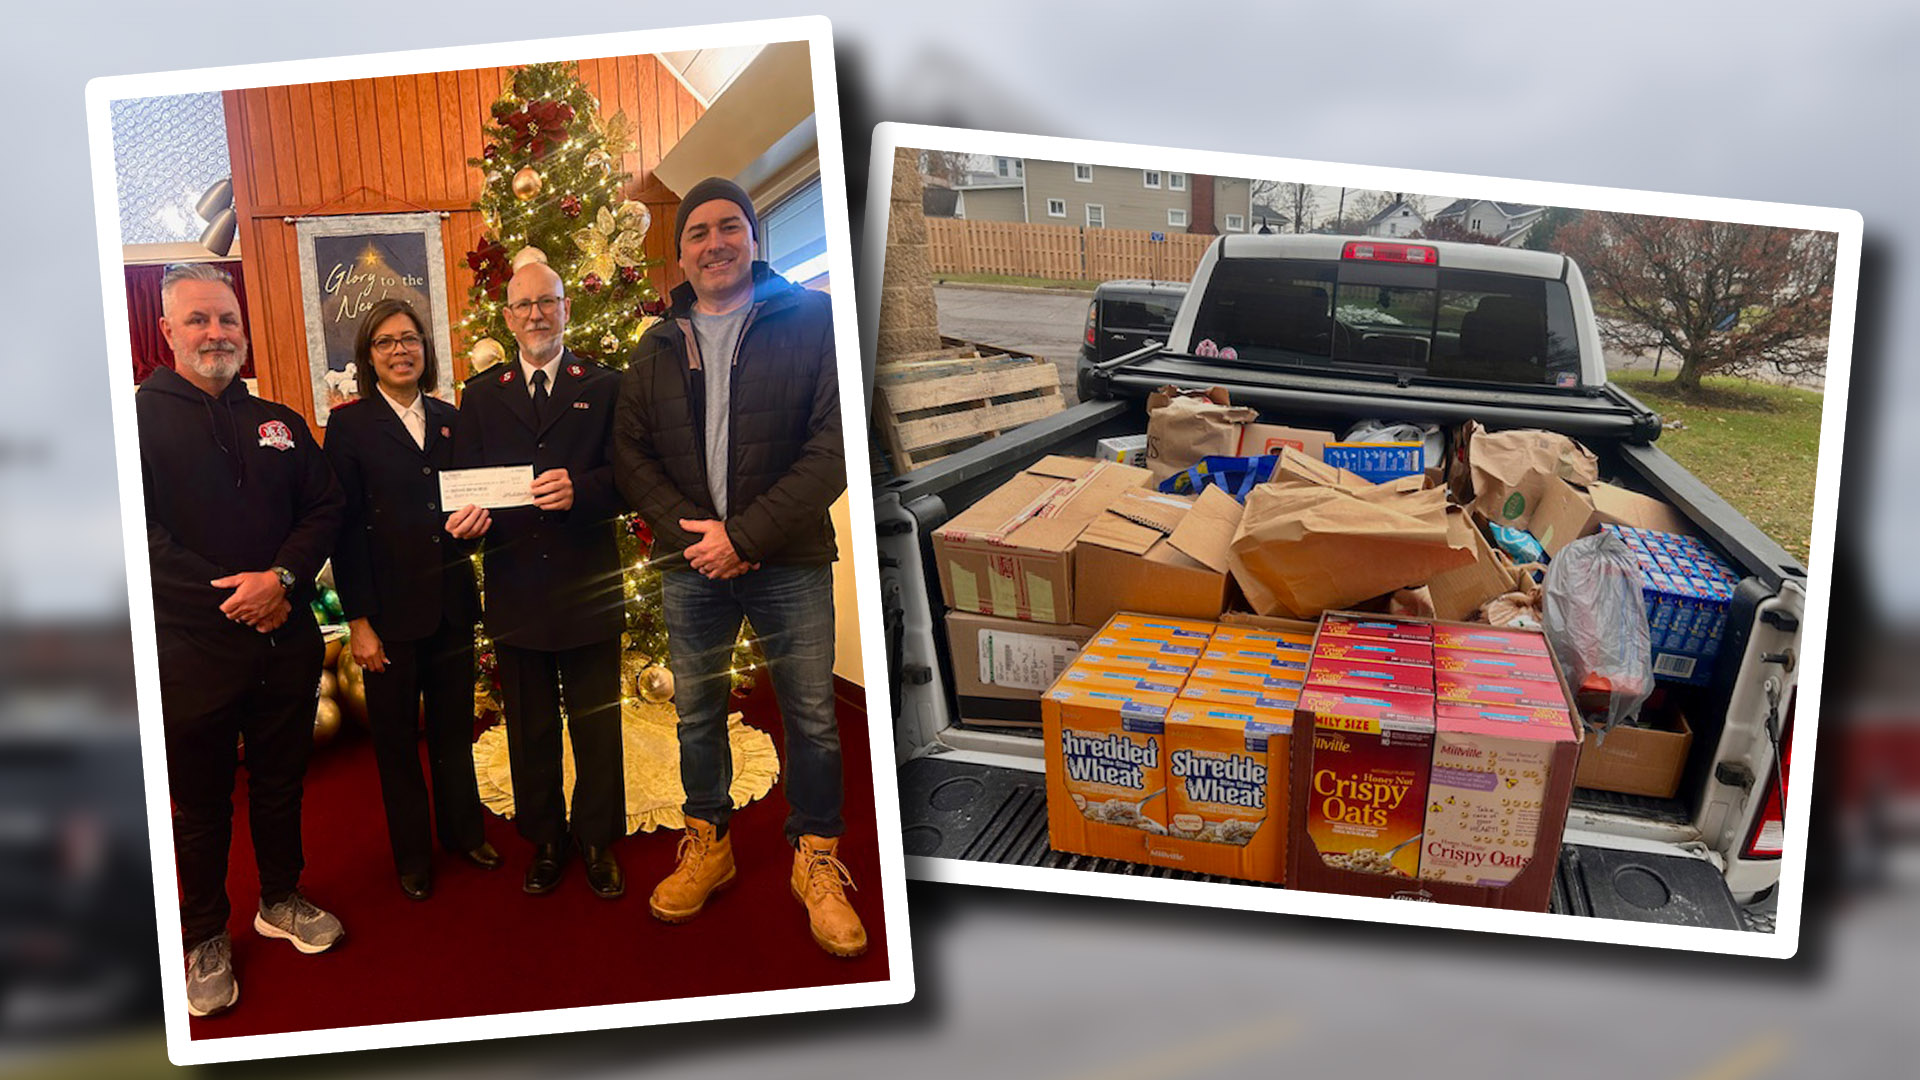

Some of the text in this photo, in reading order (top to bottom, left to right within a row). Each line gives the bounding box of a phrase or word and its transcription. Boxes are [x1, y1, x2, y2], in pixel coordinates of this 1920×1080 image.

[325, 263, 424, 297] Glory to the
[1345, 718, 1369, 731] SIZE
[1171, 749, 1267, 786] Shredde
[1440, 745, 1482, 759] Millville
[1068, 756, 1143, 789] Wheat
[1363, 773, 1414, 787] Honey Nut
[1186, 777, 1265, 809] Wheat
[1314, 769, 1408, 809] Crispy
[1322, 796, 1388, 827] Oats
[1428, 841, 1531, 868] Crispy Oats
